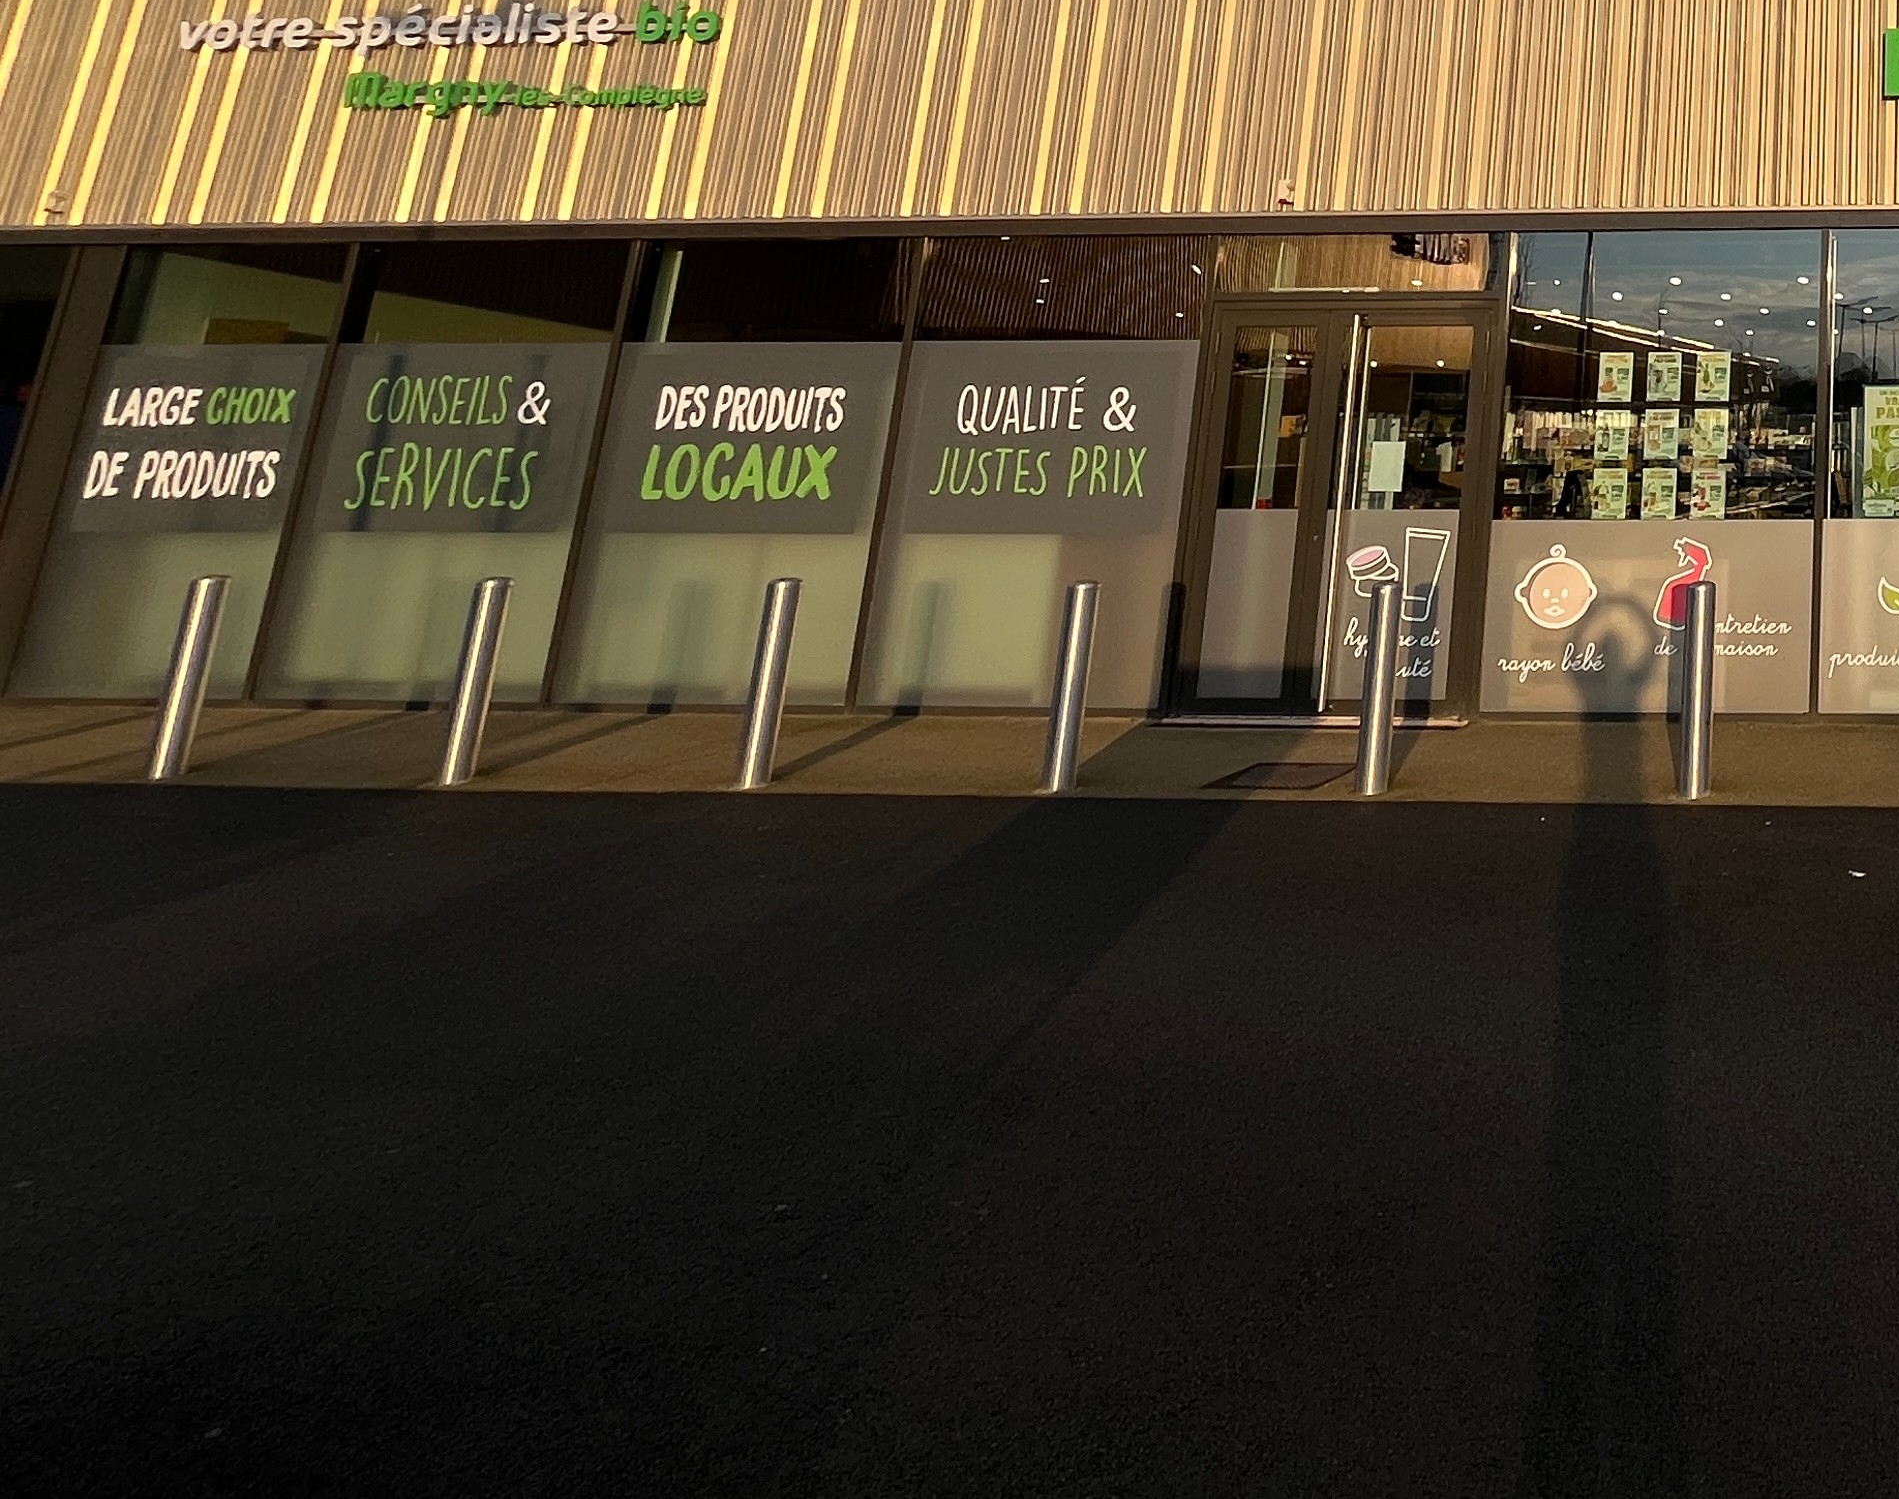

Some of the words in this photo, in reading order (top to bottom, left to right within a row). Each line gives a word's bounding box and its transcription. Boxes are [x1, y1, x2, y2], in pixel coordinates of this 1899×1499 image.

[178, 13, 315, 52] votre
[328, 2, 619, 56] spécialiste
[634, 1, 720, 44] bio
[345, 71, 509, 118] Margny
[102, 386, 203, 428] LARGE
[205, 387, 298, 425] CHOIX
[365, 375, 514, 426] CONSEILS
[516, 380, 552, 426] &
[654, 384, 706, 432] DES
[712, 384, 847, 434] PRODUITS
[956, 376, 1087, 436] QUALITÉ
[1102, 386, 1136, 433] &
[82, 450, 129, 499] DE
[133, 450, 281, 500] PRODUITS
[343, 442, 539, 511] SERVICES
[640, 443, 839, 502] LOCAUX
[929, 447, 1051, 497] JUSTES
[1066, 445, 1148, 499] PRIX
[1420, 627, 1441, 647] et
[1654, 636, 1678, 655] de
[1715, 613, 1792, 634] ntretien
[1498, 658, 1556, 683] rayon
[1561, 642, 1605, 671] bébé
